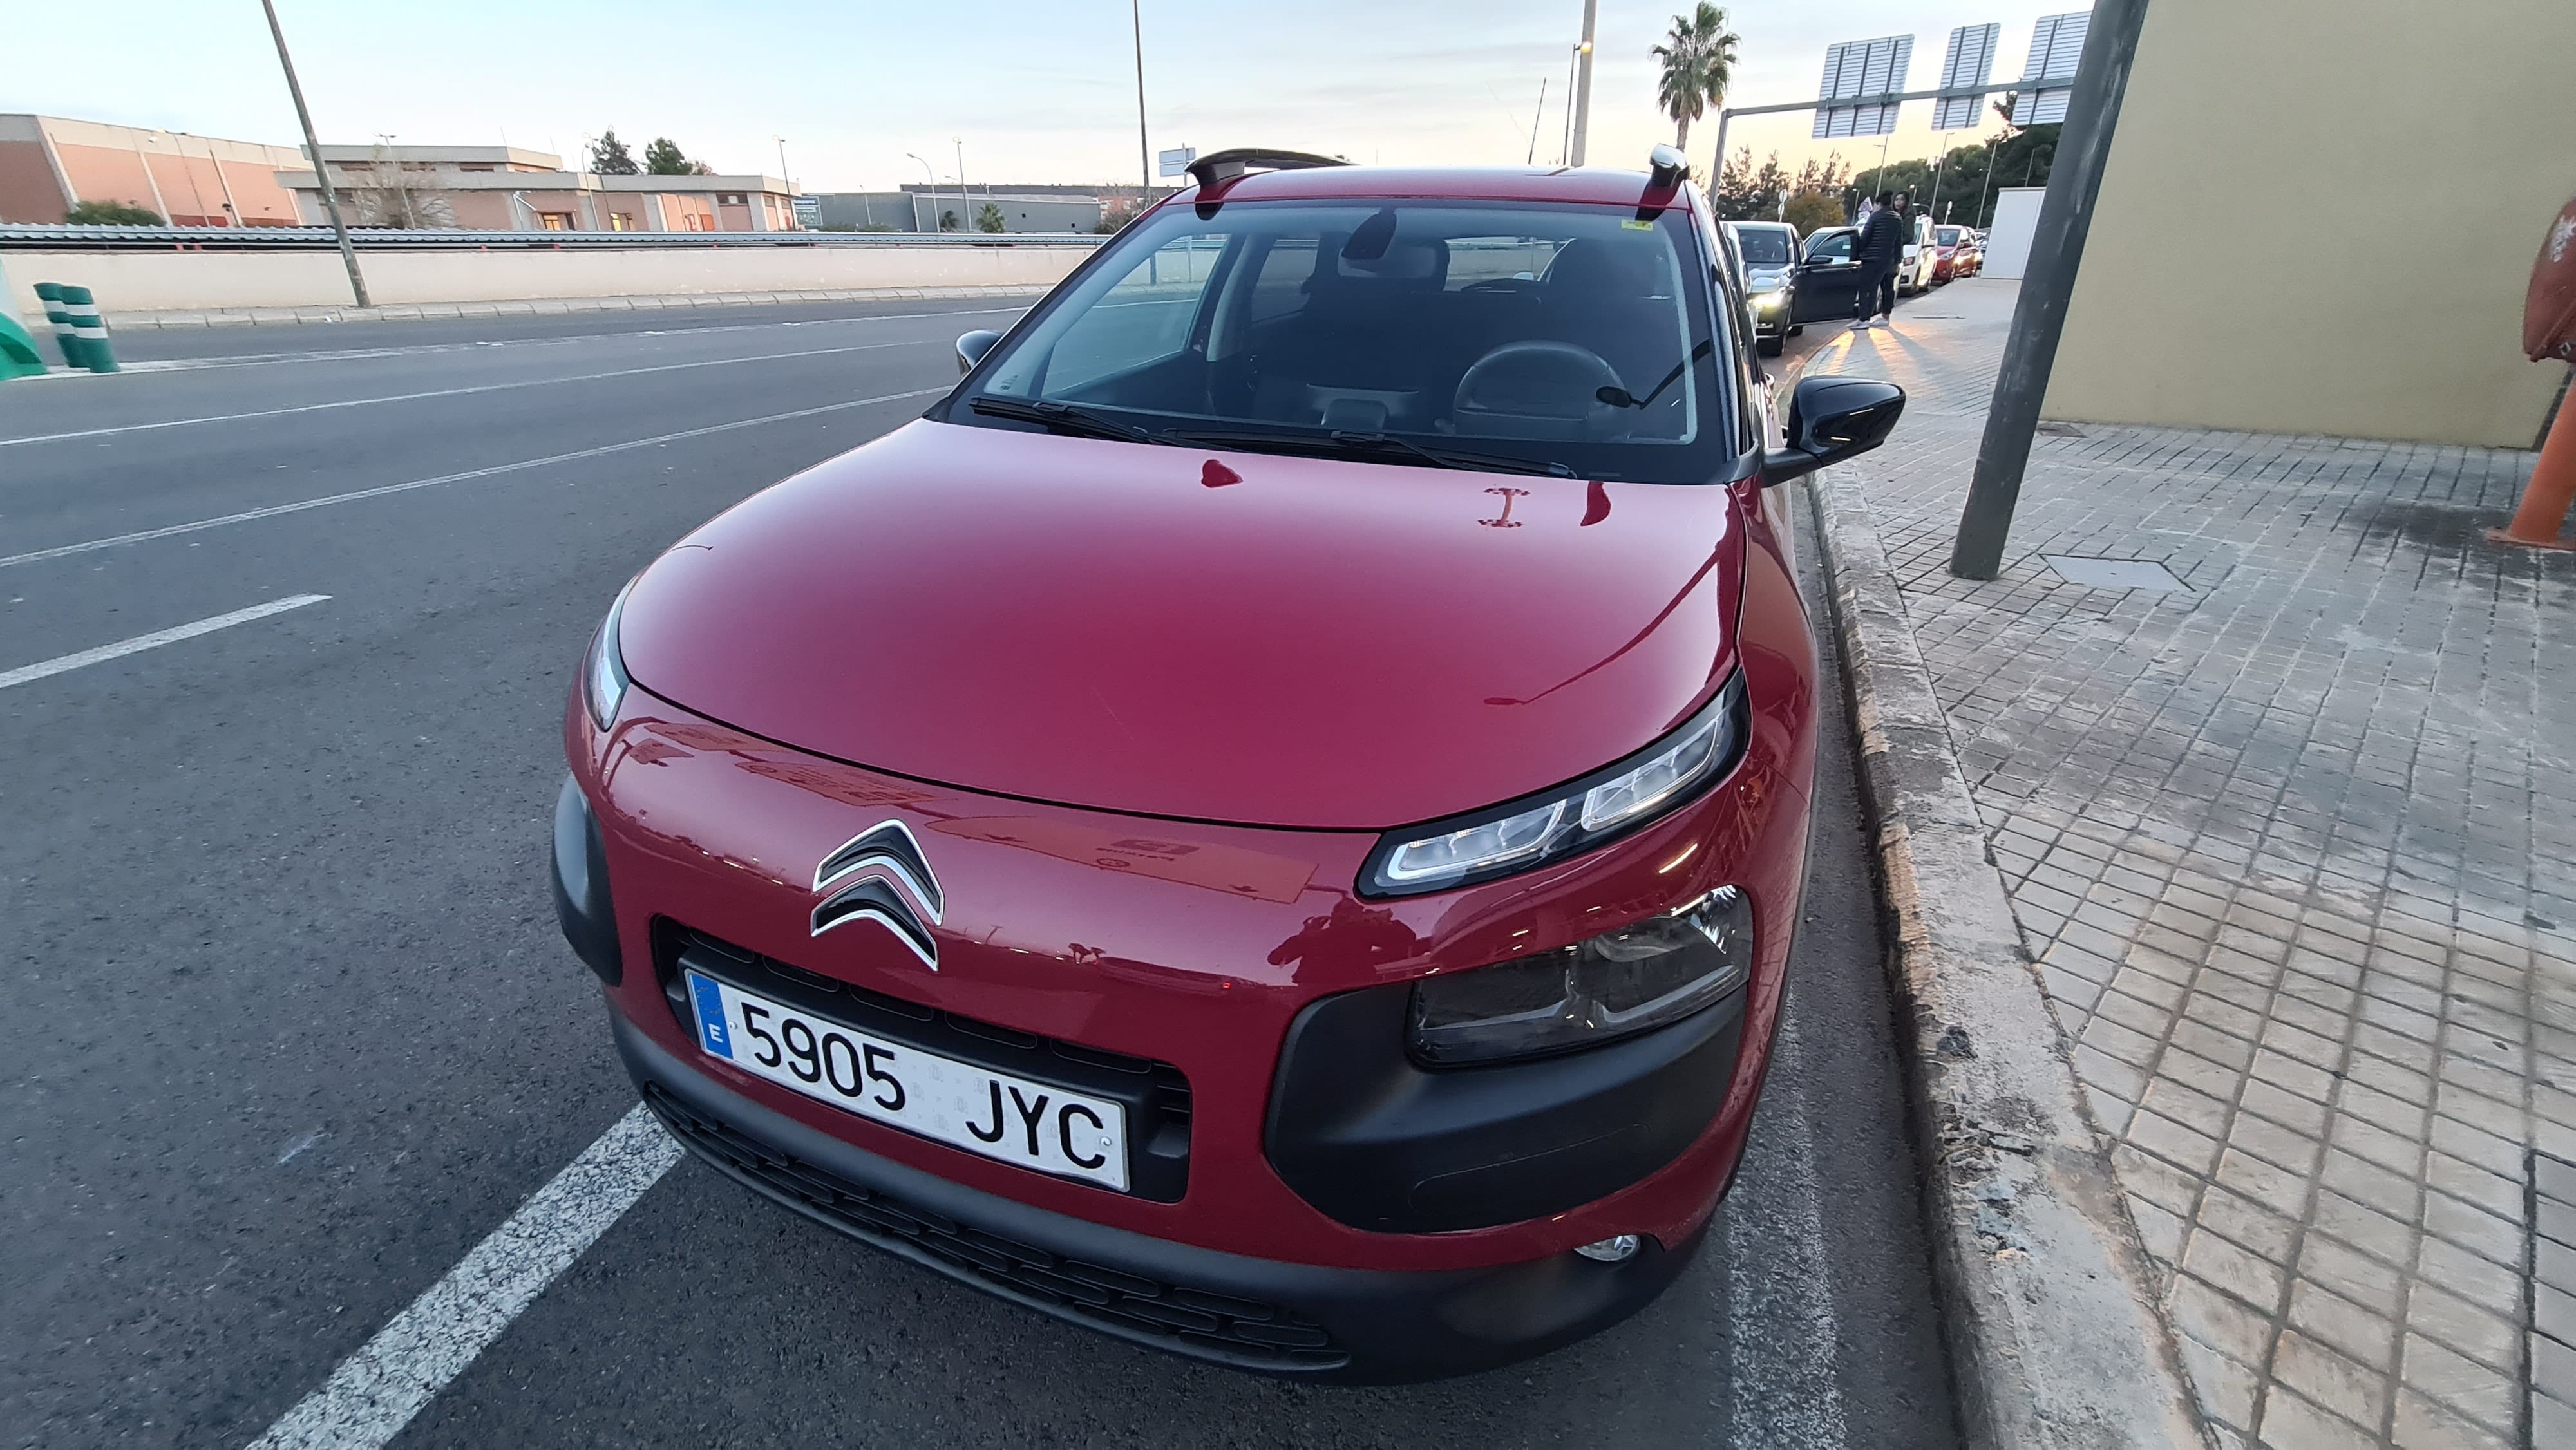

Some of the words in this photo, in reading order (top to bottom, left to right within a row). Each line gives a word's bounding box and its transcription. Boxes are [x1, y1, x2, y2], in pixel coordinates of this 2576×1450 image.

[708, 1023, 723, 1043] E
[741, 1002, 905, 1111] 5905
[965, 1079, 1106, 1169] JYC
